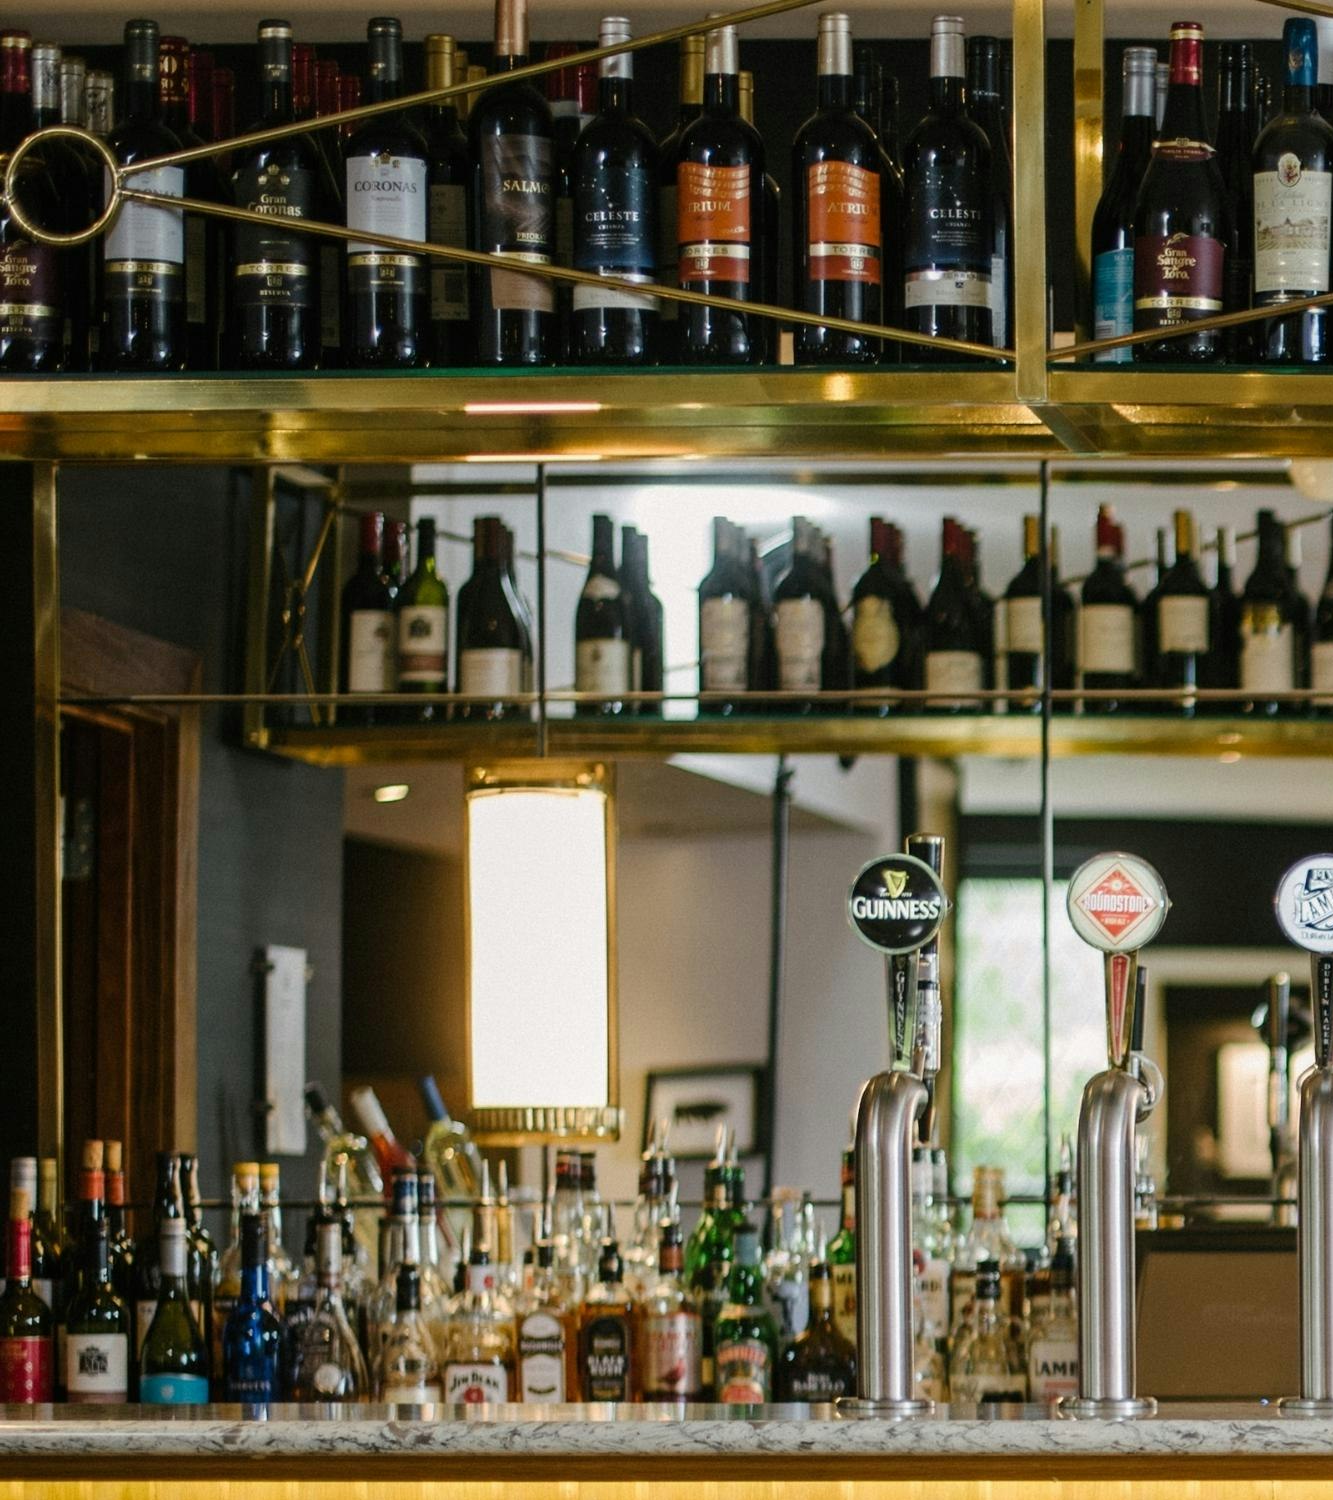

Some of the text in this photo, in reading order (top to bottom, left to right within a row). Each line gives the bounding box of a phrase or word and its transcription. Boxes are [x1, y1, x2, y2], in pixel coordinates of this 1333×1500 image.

[354, 180, 417, 194] CORONAS
[260, 194, 286, 204] Gran
[585, 211, 639, 223] CELESTE
[1164, 248, 1188, 257] Gran
[5, 254, 28, 264] Gran
[361, 256, 417, 265] TORRES
[1157, 256, 1196, 268] Sangre
[250, 265, 304, 274] TORRES
[1163, 267, 1189, 281] Toro
[853, 896, 940, 920] GUINNESS
